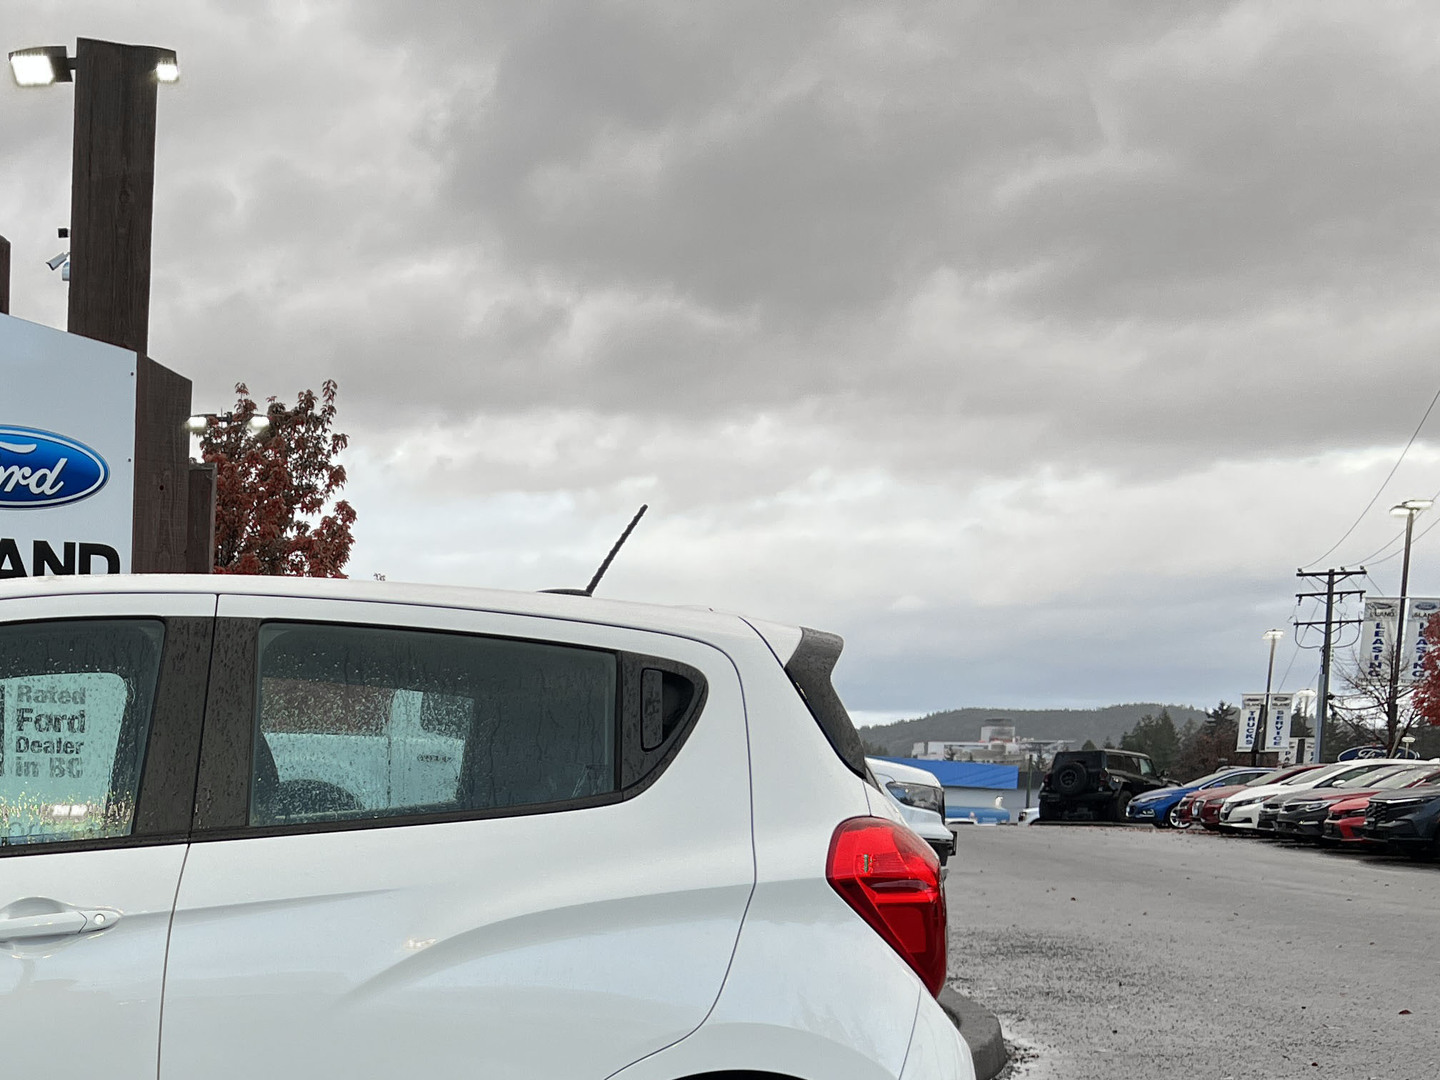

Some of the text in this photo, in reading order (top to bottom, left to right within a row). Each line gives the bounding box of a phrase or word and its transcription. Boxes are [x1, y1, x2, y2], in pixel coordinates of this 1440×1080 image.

[1368, 622, 1385, 678] LEASING
[16, 684, 86, 705] Rated
[15, 708, 86, 734] Ford
[1245, 710, 1256, 745] TRUCKS
[1273, 710, 1284, 746] SERVICE
[15, 736, 85, 755] Dealer
[15, 757, 39, 778] in
